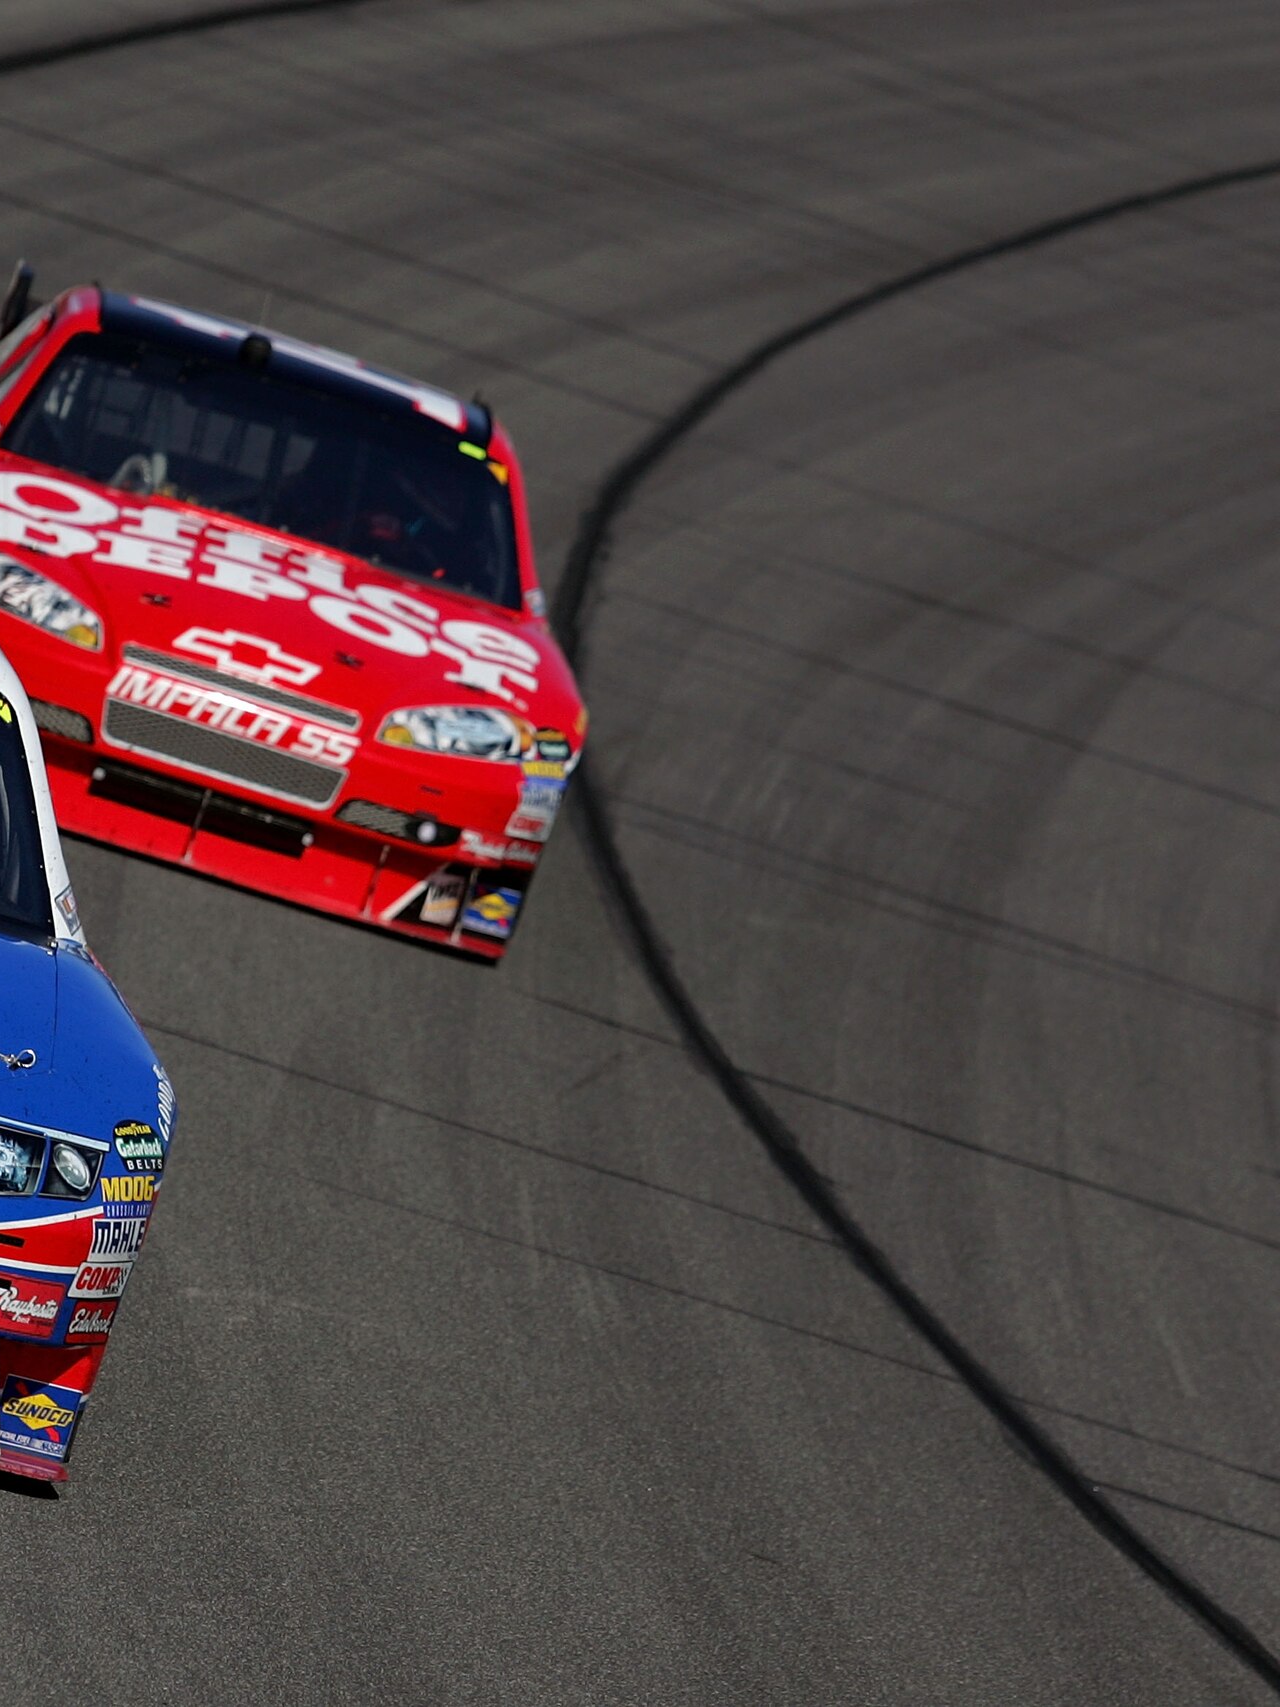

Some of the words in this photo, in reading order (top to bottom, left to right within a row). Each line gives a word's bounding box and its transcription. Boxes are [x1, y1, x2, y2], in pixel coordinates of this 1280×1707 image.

[107, 663, 293, 745] IMPALA
[290, 723, 362, 765] SS
[115, 1137, 164, 1159] Gatorback
[126, 1159, 163, 1171] BELTS
[100, 1175, 156, 1203] MOOG
[91, 1221, 146, 1254] MAHLE
[76, 1266, 122, 1291] COMP
[5, 1398, 73, 1425] SUNOCO
